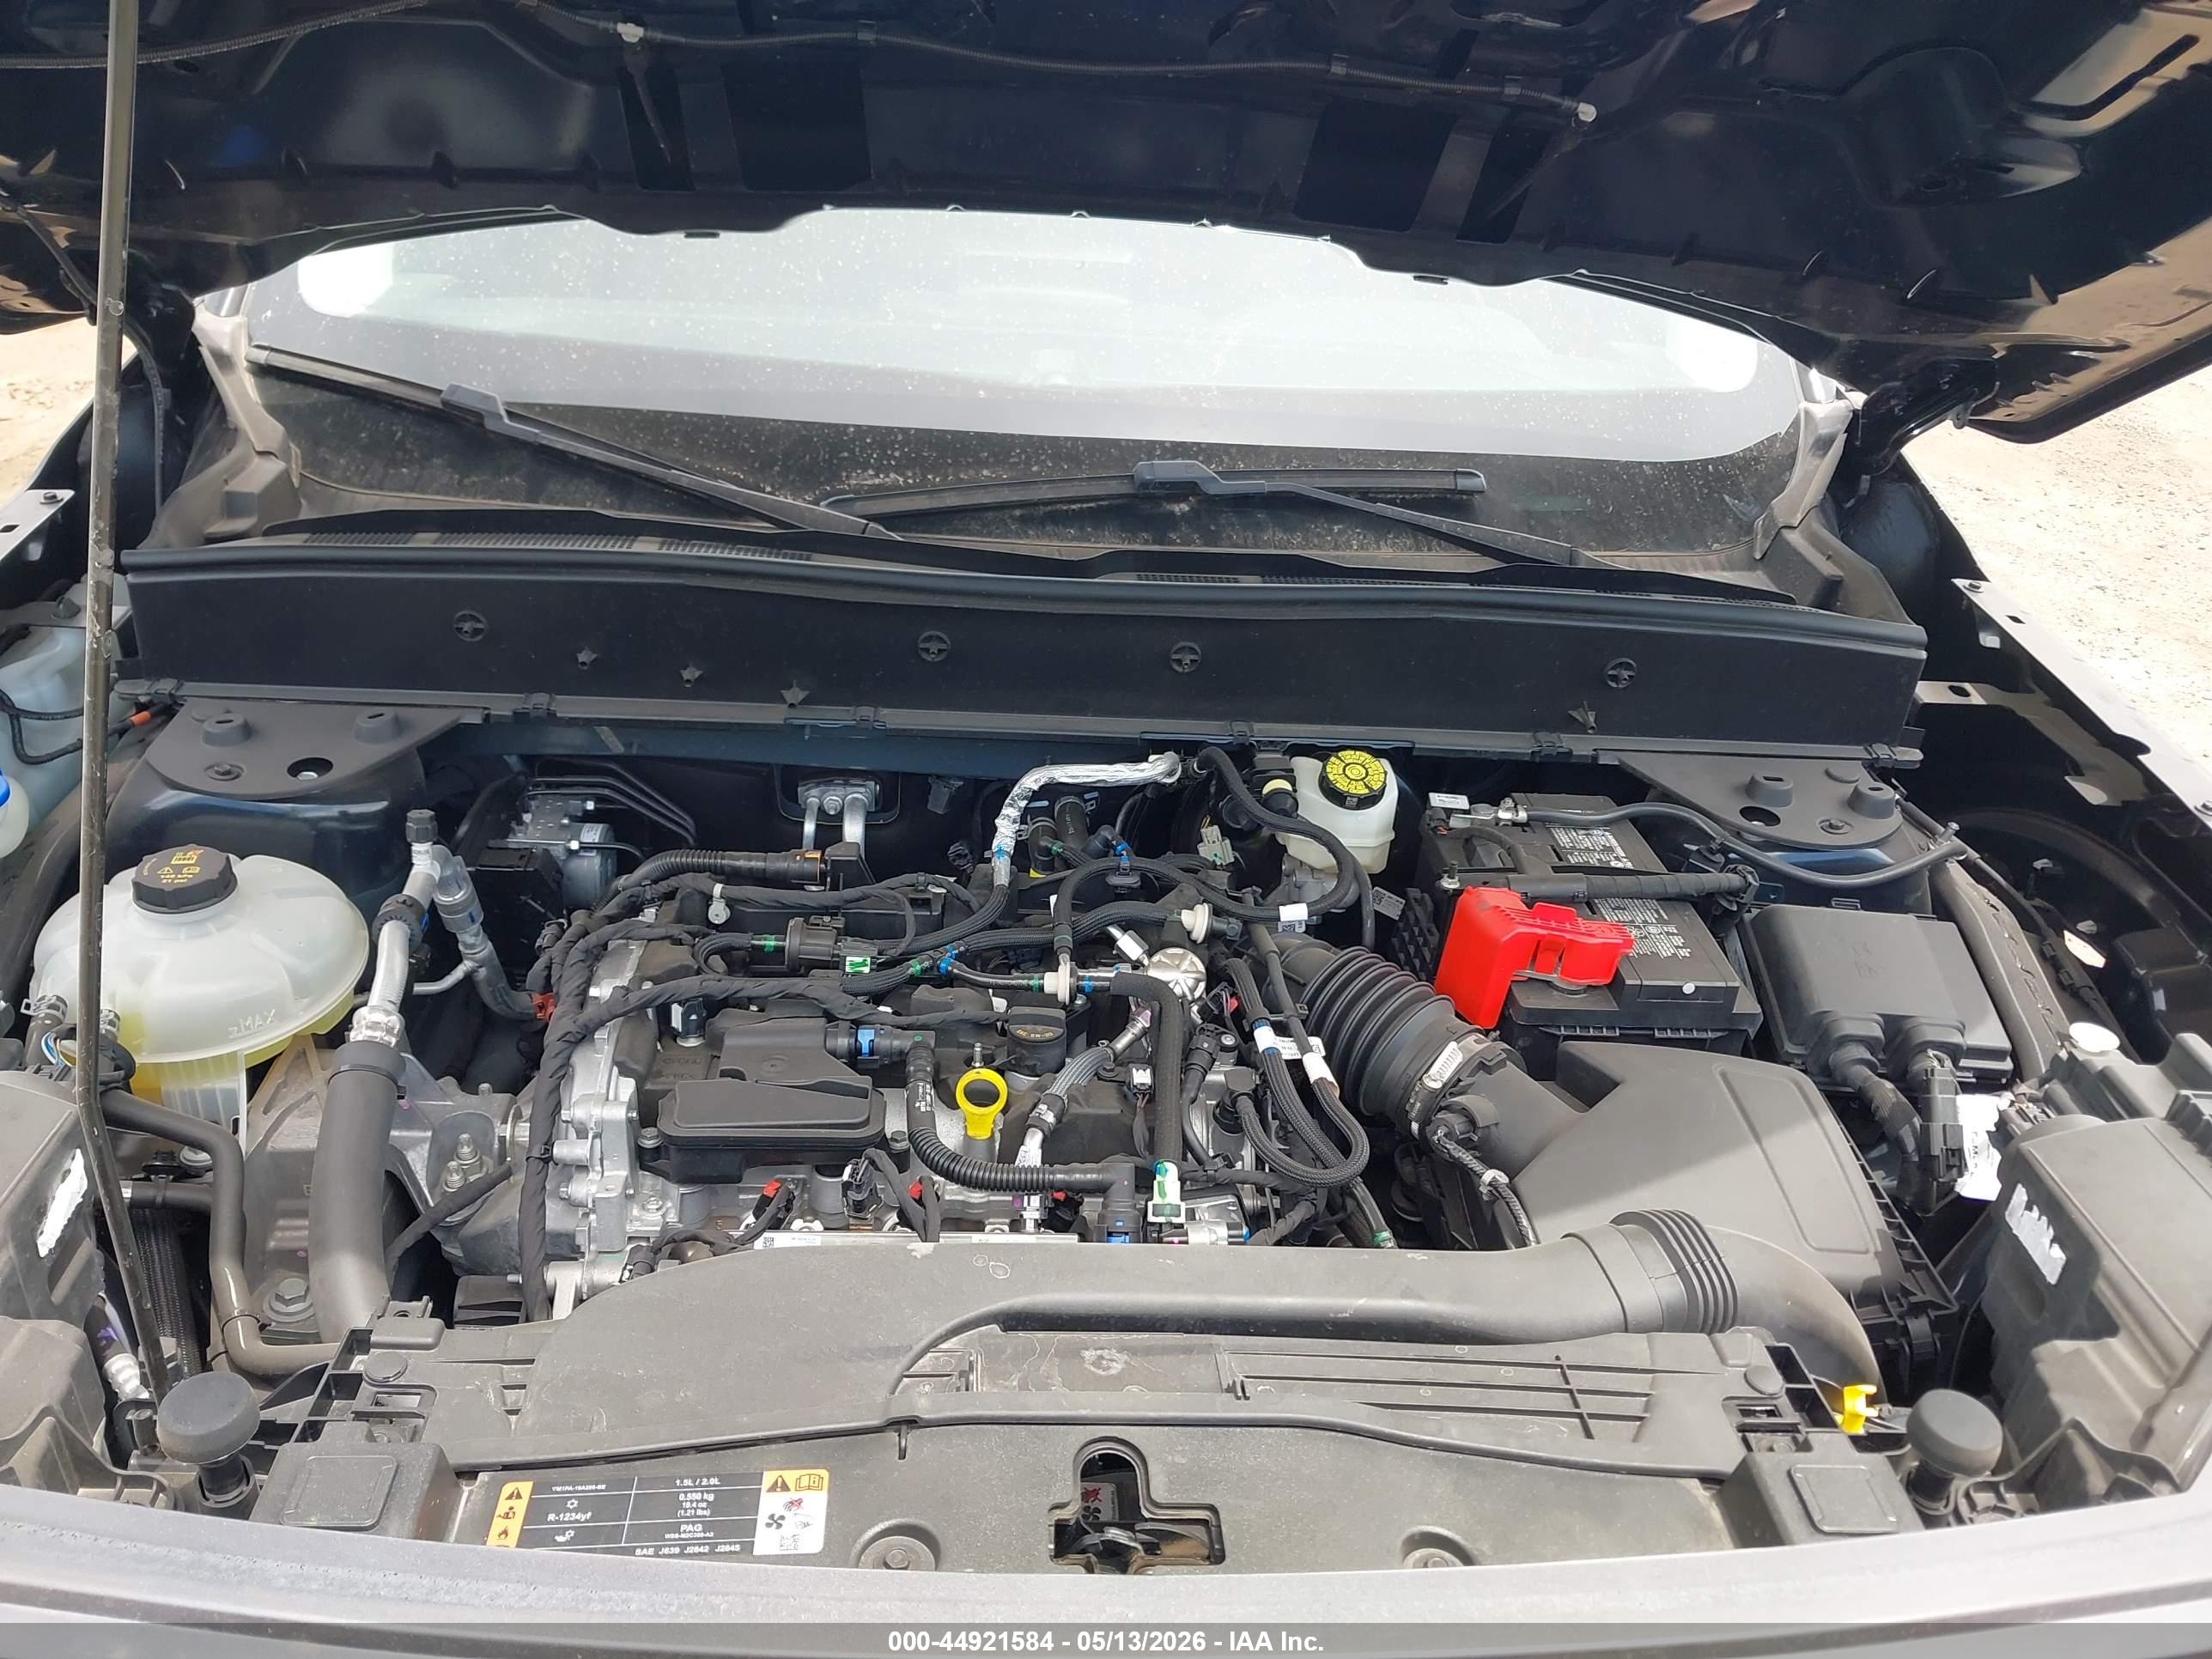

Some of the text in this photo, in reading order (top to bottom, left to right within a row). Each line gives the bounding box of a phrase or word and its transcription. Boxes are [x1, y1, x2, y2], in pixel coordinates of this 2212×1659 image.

[701, 1477, 721, 1486] 2.0L
[678, 1492, 714, 1502] 0.550 kg
[547, 1511, 592, 1522] R-1234yf
[680, 1524, 702, 1533] PAG
[635, 1547, 654, 1556] SAE
